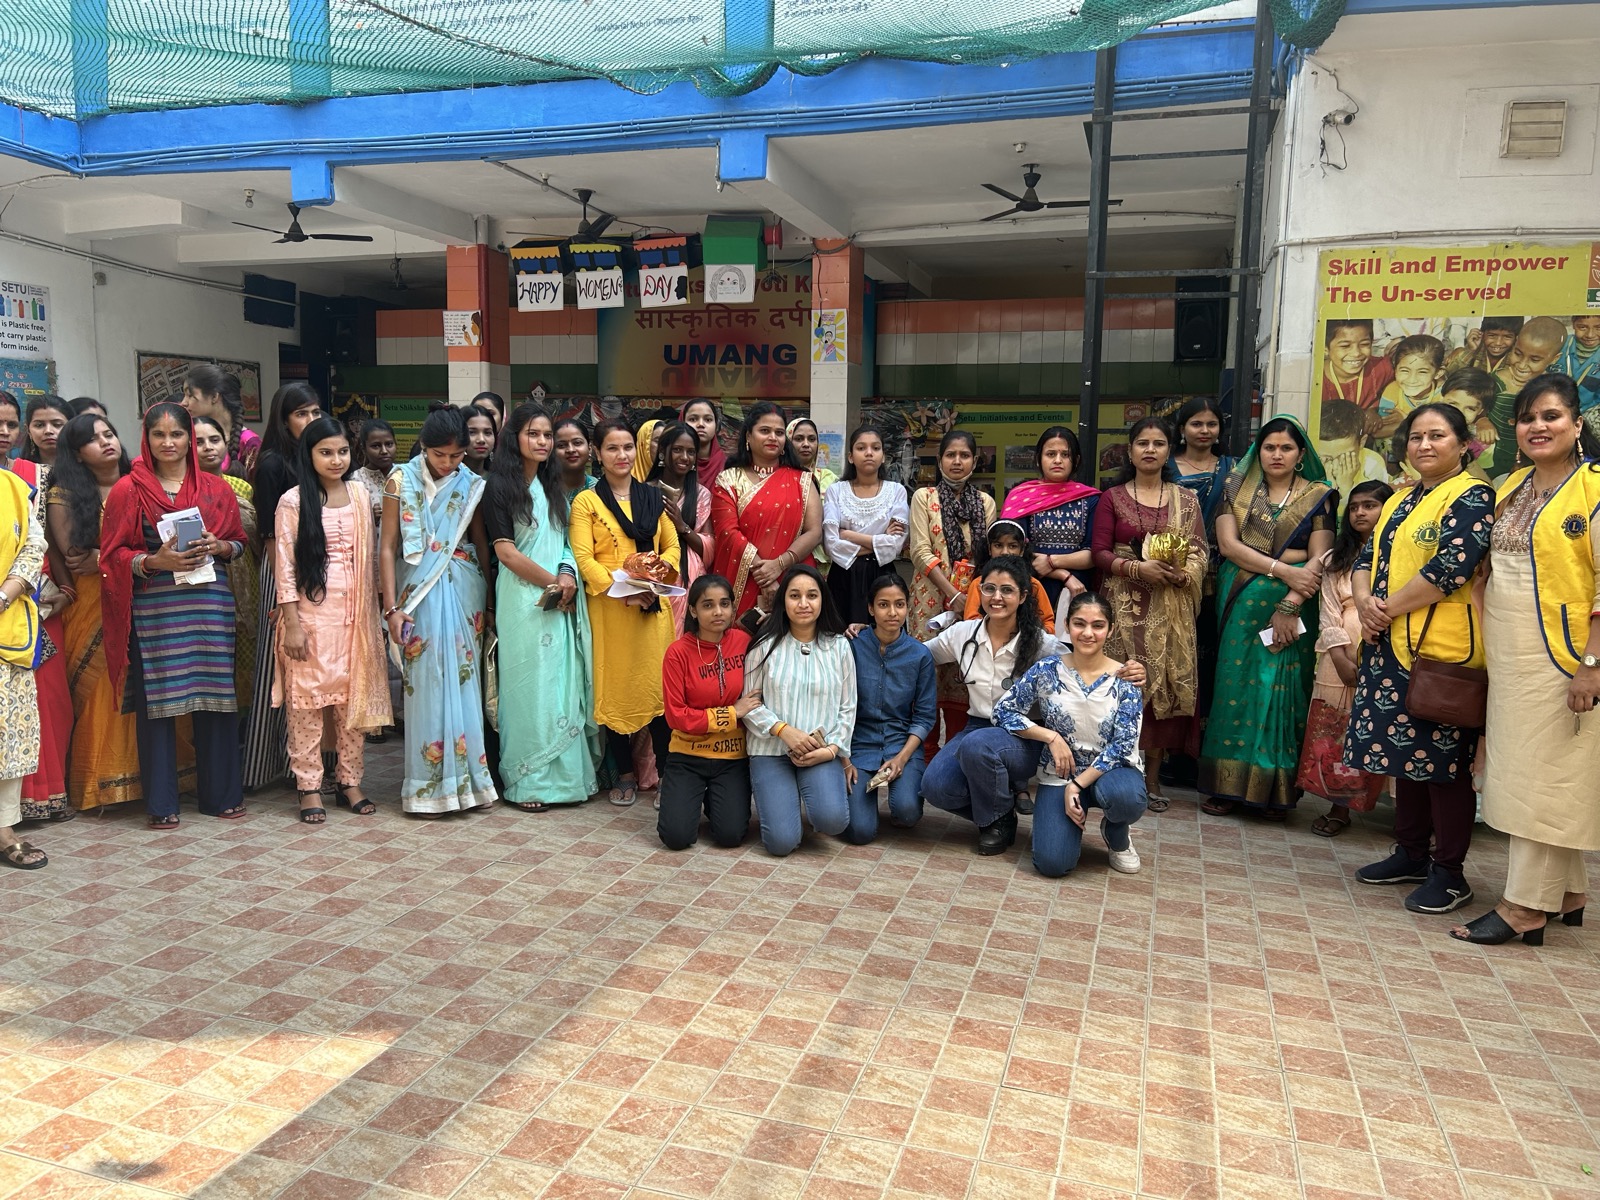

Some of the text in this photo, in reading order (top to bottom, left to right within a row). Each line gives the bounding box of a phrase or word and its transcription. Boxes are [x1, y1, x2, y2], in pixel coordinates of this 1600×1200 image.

[1328, 255, 1569, 276] Skill and Empower
[2, 282, 27, 295] SETU
[519, 281, 561, 304] HAPPY
[644, 275, 673, 302] DAY
[1326, 283, 1511, 304] The Un-served
[9, 321, 30, 330] Plastic
[31, 323, 46, 332] free,
[7, 333, 24, 341] carry
[26, 334, 47, 343] plastic
[19, 343, 40, 352] inside.
[664, 344, 797, 365] UMANG
[960, 413, 1064, 422] Setu Initiatives and Events
[1571, 521, 1579, 531] L
[1424, 529, 1434, 540] L
[691, 741, 695, 750] I
[713, 738, 743, 753] STREET
